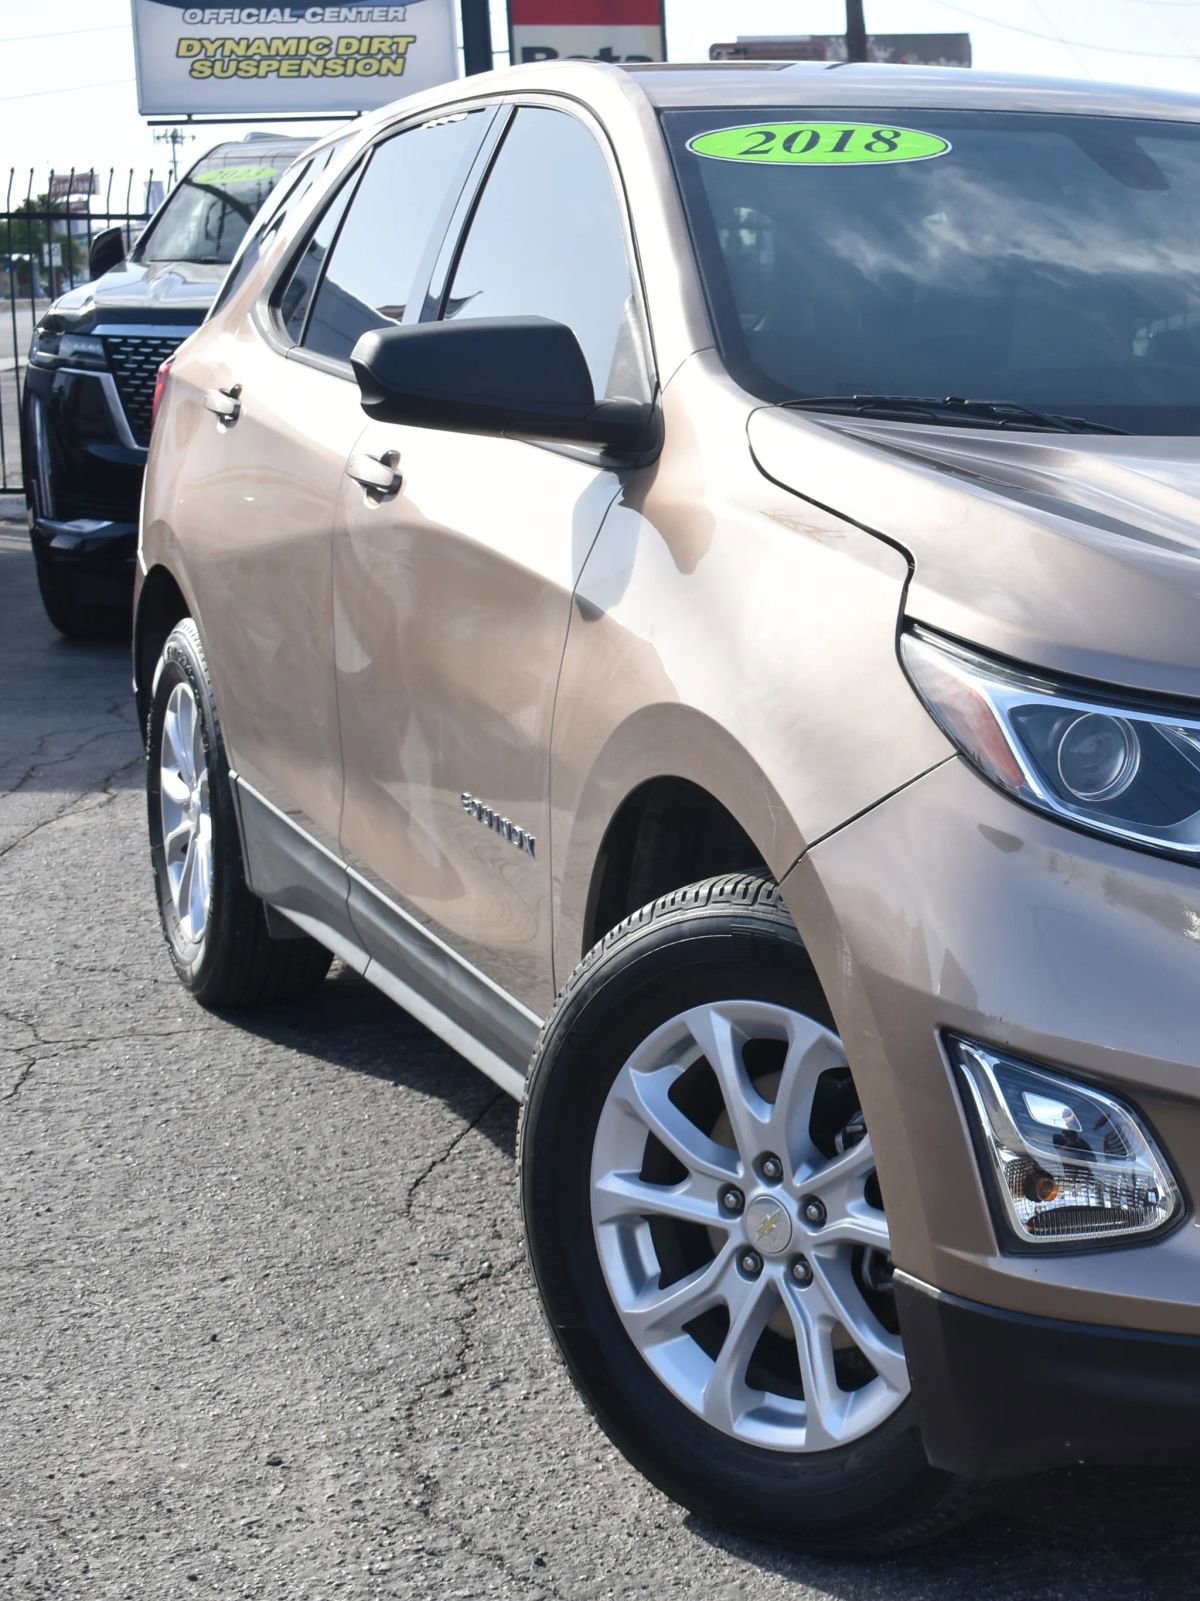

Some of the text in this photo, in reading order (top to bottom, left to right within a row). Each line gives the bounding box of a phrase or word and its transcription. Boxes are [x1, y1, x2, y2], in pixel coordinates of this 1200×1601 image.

[183, 6, 406, 24] OFFICIAL CENTER
[177, 35, 416, 57] DYNAMIC DIRT
[189, 57, 406, 79] SUSPENSION
[738, 129, 902, 156] 2018
